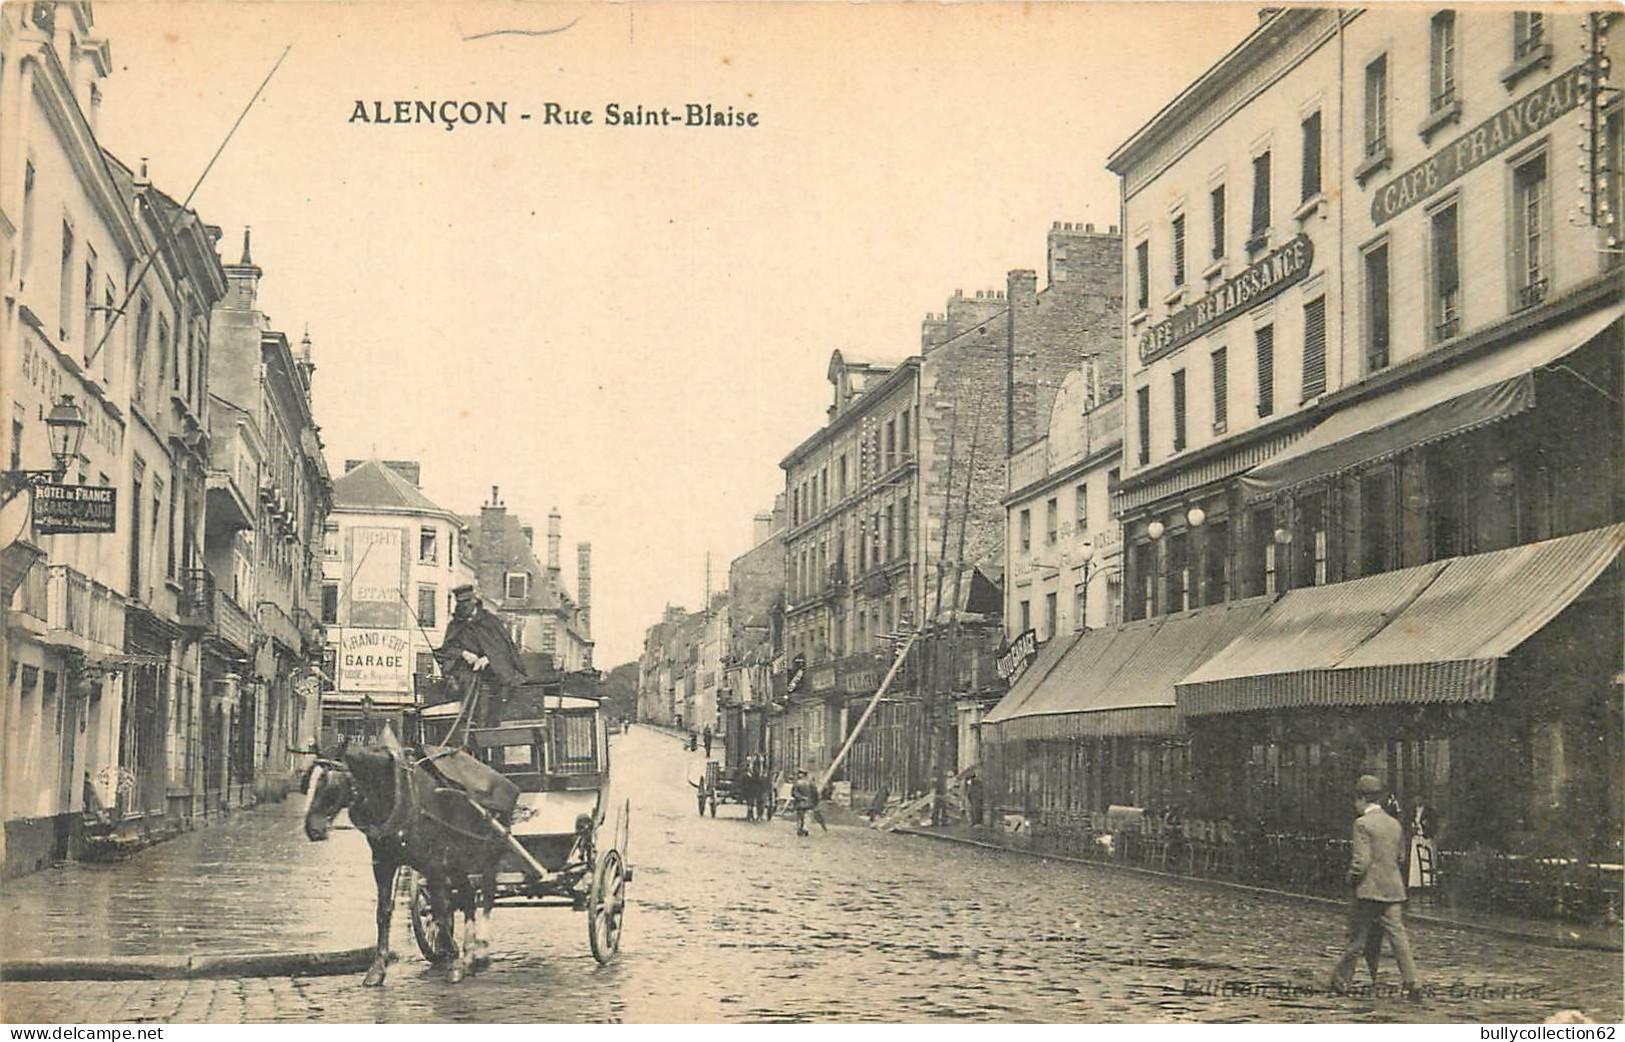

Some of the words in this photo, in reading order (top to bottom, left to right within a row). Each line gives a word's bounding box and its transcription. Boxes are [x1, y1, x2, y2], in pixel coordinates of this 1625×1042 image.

[1197, 241, 1305, 322] RENAISSANCE
[75, 487, 111, 502] FRANCE
[345, 655, 403, 667] GARAGE
